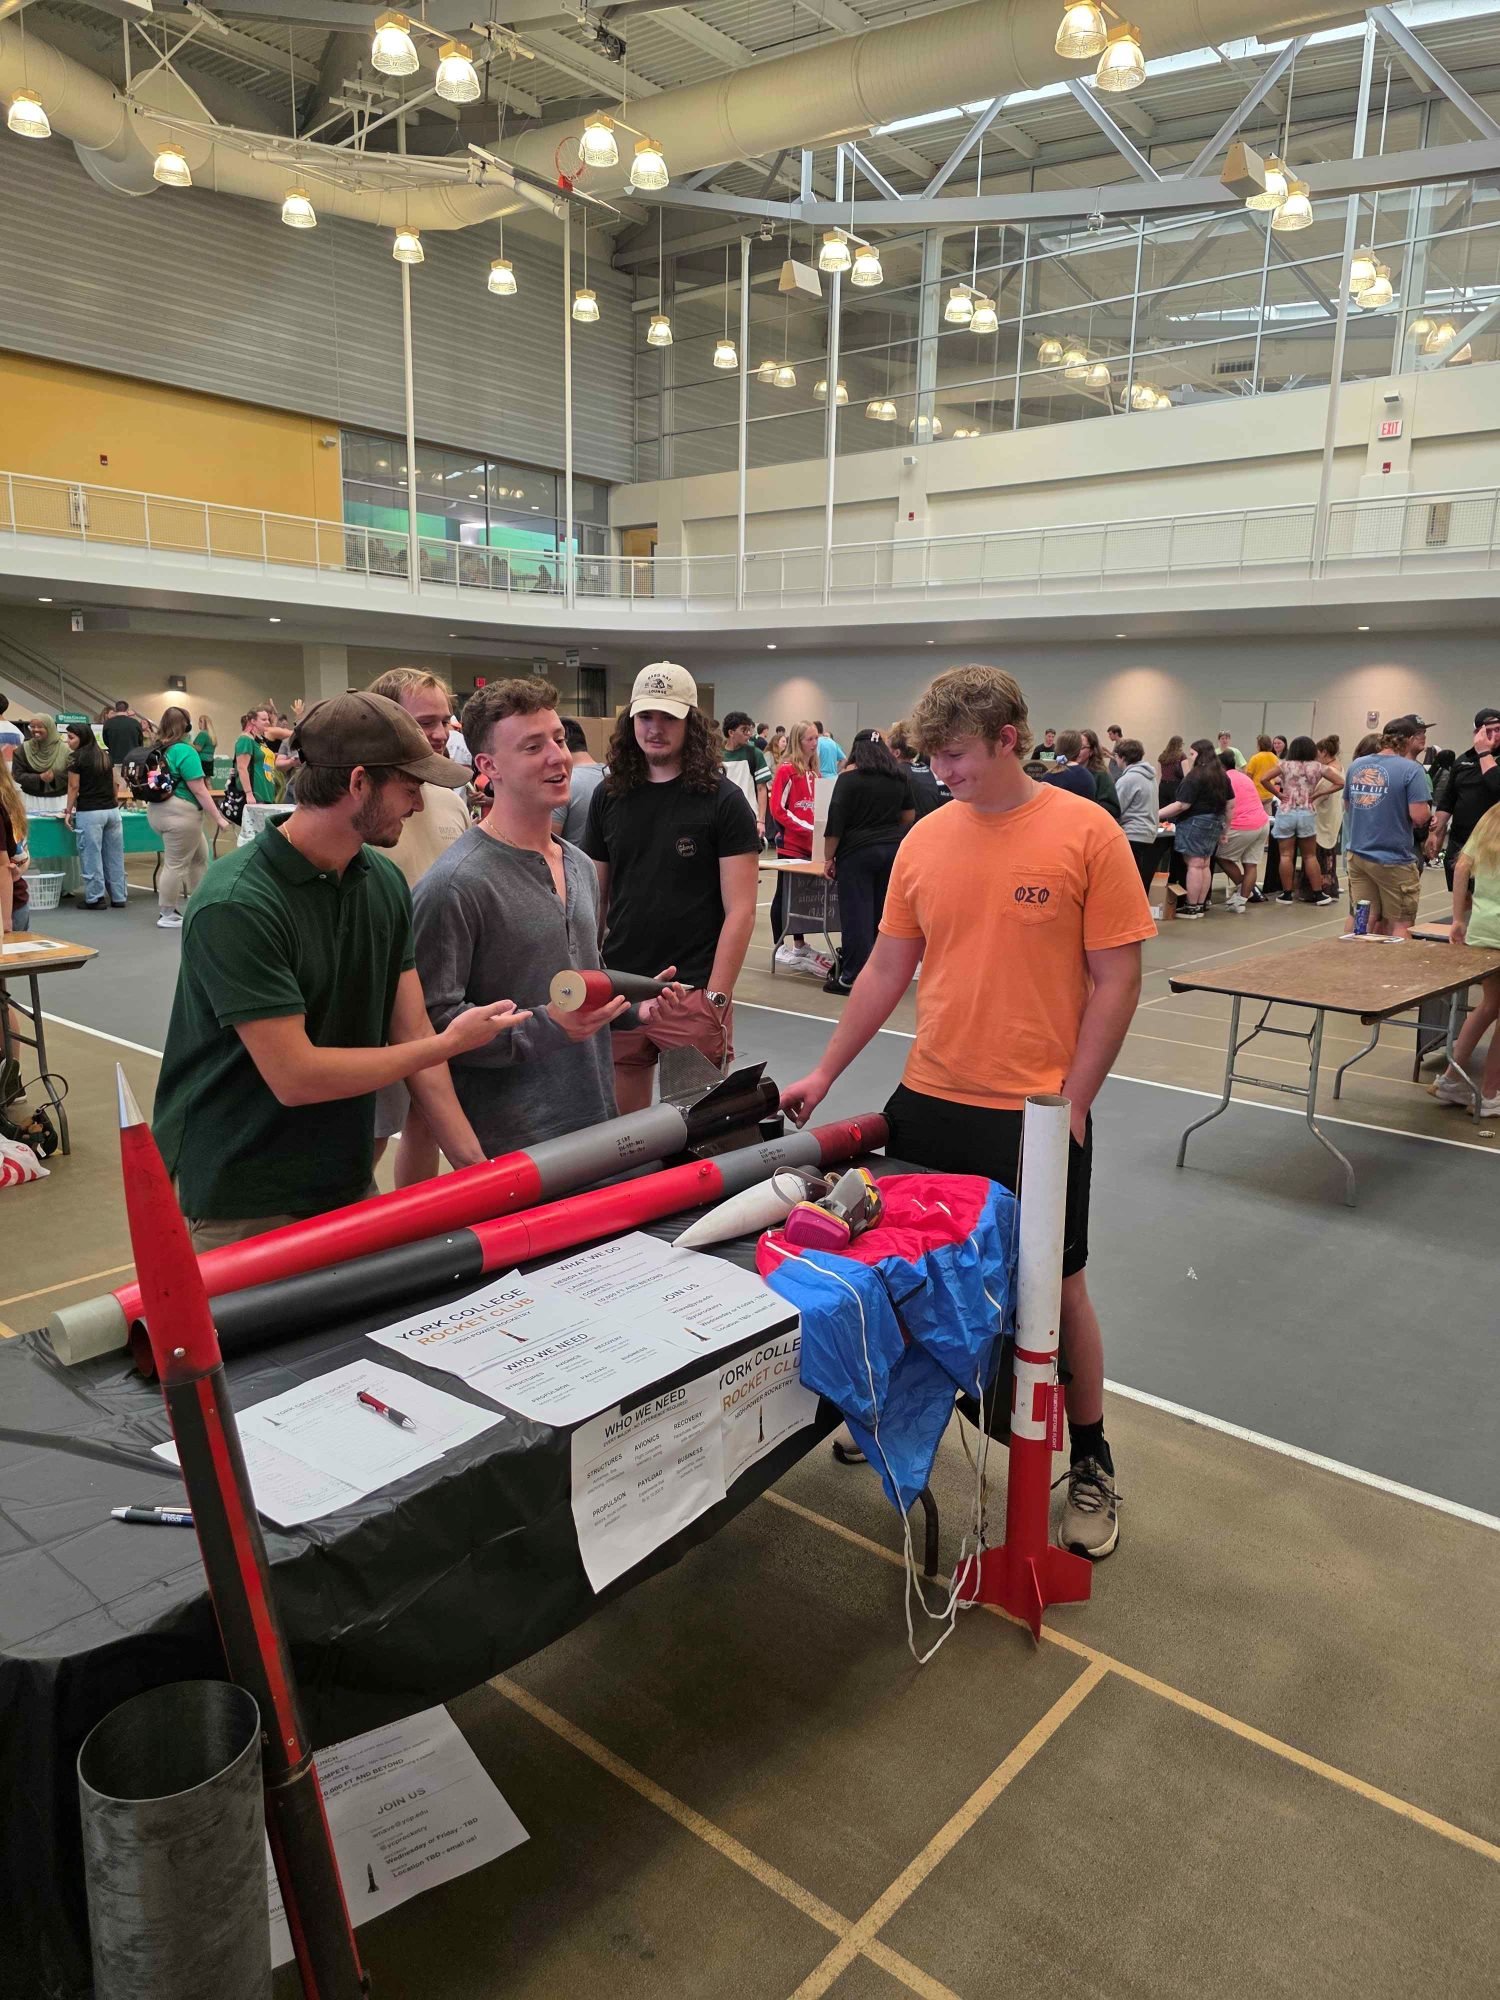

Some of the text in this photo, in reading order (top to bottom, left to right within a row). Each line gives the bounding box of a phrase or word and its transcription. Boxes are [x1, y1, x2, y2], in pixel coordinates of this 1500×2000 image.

[1381, 421, 1399, 436] EXIT
[1370, 786, 1389, 794] LIFE
[557, 1246, 621, 1271] WHAT WE DO
[661, 1283, 700, 1302] JOIN US
[395, 1288, 526, 1341] YORK COLLEGE
[417, 1315, 488, 1346] ROCKET
[490, 1297, 534, 1318] CLUB
[496, 1311, 532, 1328] ROCKETRY
[503, 1356, 535, 1372] WHO
[533, 1346, 557, 1359] WE
[555, 1333, 589, 1350] NEED
[719, 1337, 801, 1390] YORK COLLE
[723, 1357, 801, 1412] ROCKET CLU
[734, 1379, 794, 1419] HIGH-POWER ROCKETRY
[604, 1388, 686, 1438] WHO WE NEED
[586, 1453, 623, 1479] STRUCTURES
[634, 1433, 661, 1451] AVIONICS
[673, 1410, 703, 1430] RECOVERY
[592, 1491, 627, 1518] PROPULSION
[637, 1469, 663, 1488] PAYLOAD
[677, 1446, 704, 1465] BUSINESS
[319, 1764, 350, 1782] OMPETE
[355, 1771, 371, 1781] AND
[372, 1758, 404, 1774] BEYOND
[377, 1787, 426, 1815] JOIN US
[385, 1841, 428, 1864] Wednesday
[436, 1827, 458, 1841] Friday
[463, 1817, 479, 1828] TBD
[392, 1860, 425, 1878] Location
[425, 1851, 441, 1862] TBD
[446, 1839, 465, 1853] email
